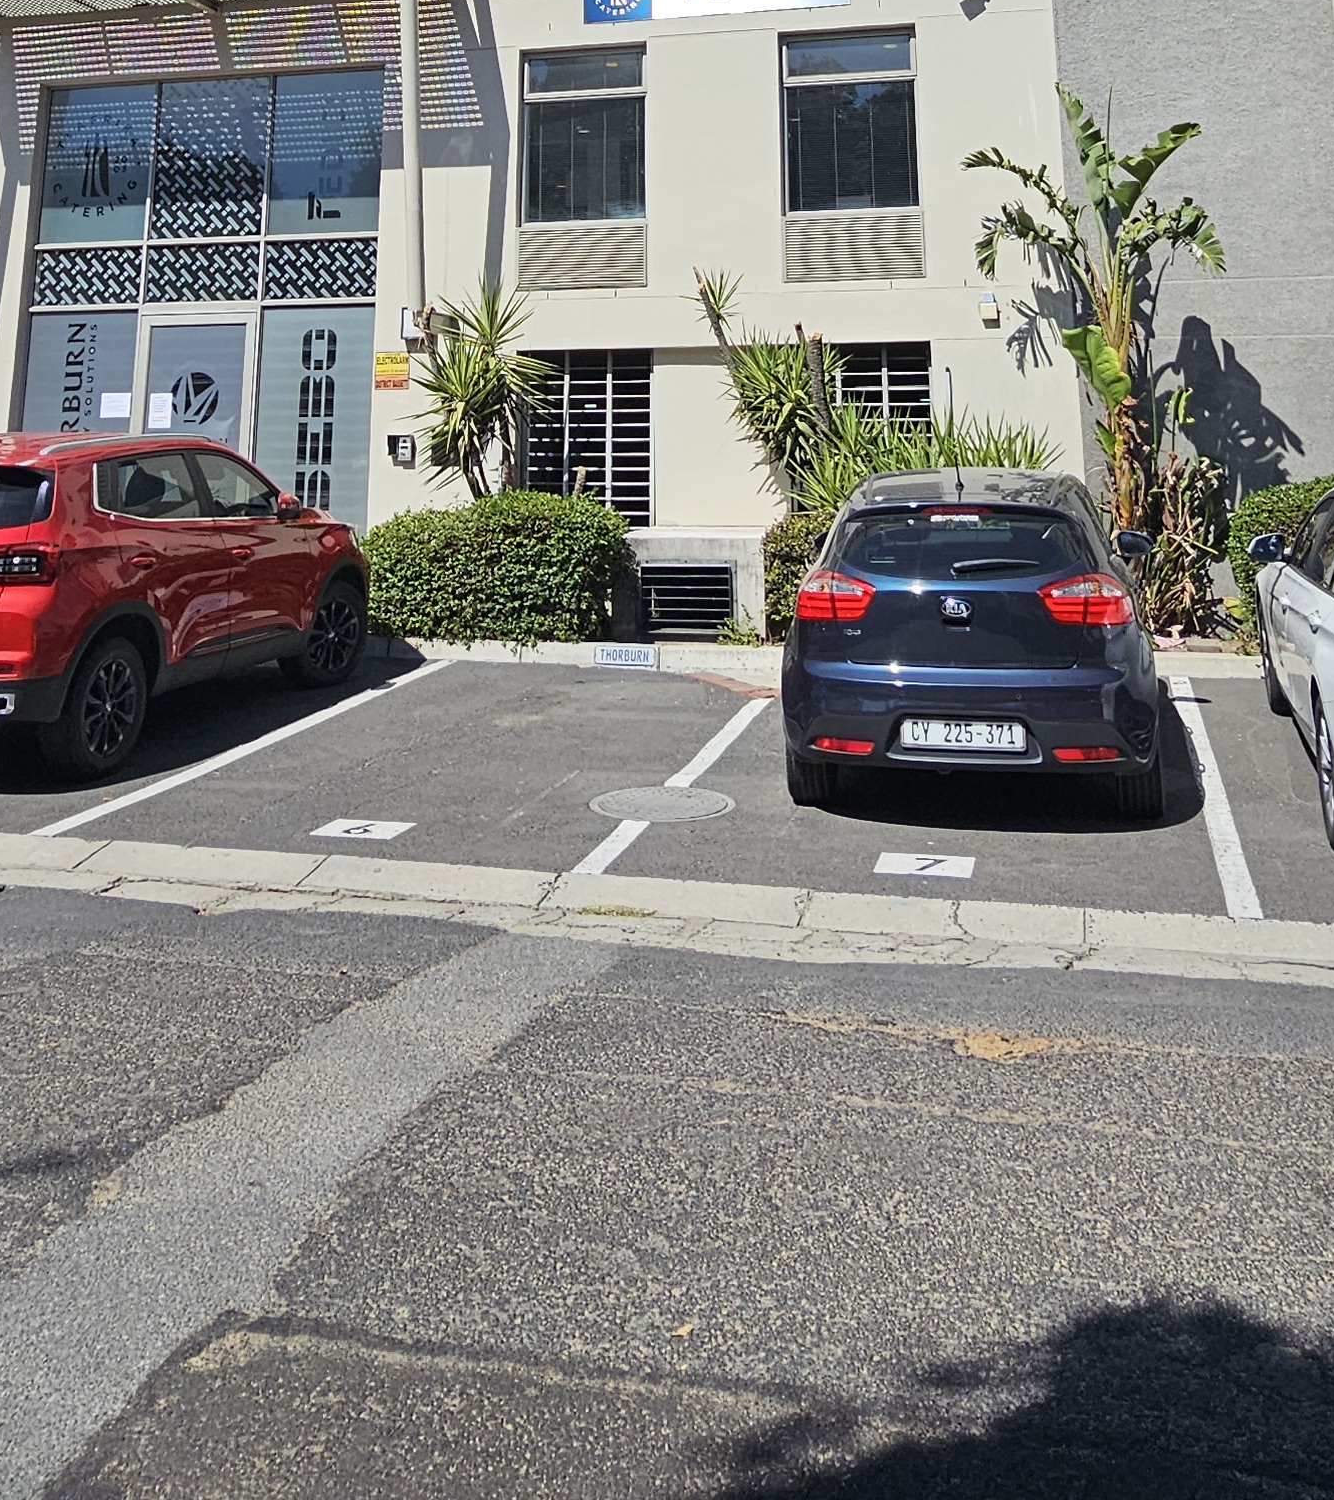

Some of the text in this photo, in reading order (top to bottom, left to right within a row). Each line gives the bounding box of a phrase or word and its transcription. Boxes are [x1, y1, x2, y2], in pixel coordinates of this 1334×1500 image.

[53, 180, 137, 218] CATERING
[60, 323, 87, 433] RBURN
[84, 324, 98, 417] SOLUTIONS
[295, 329, 338, 511] SEBO
[944, 602, 967, 615] KIA
[599, 648, 650, 663] THORBURN
[911, 721, 1016, 745] CY 225-371
[341, 823, 377, 835] 6
[915, 857, 948, 871] 7
